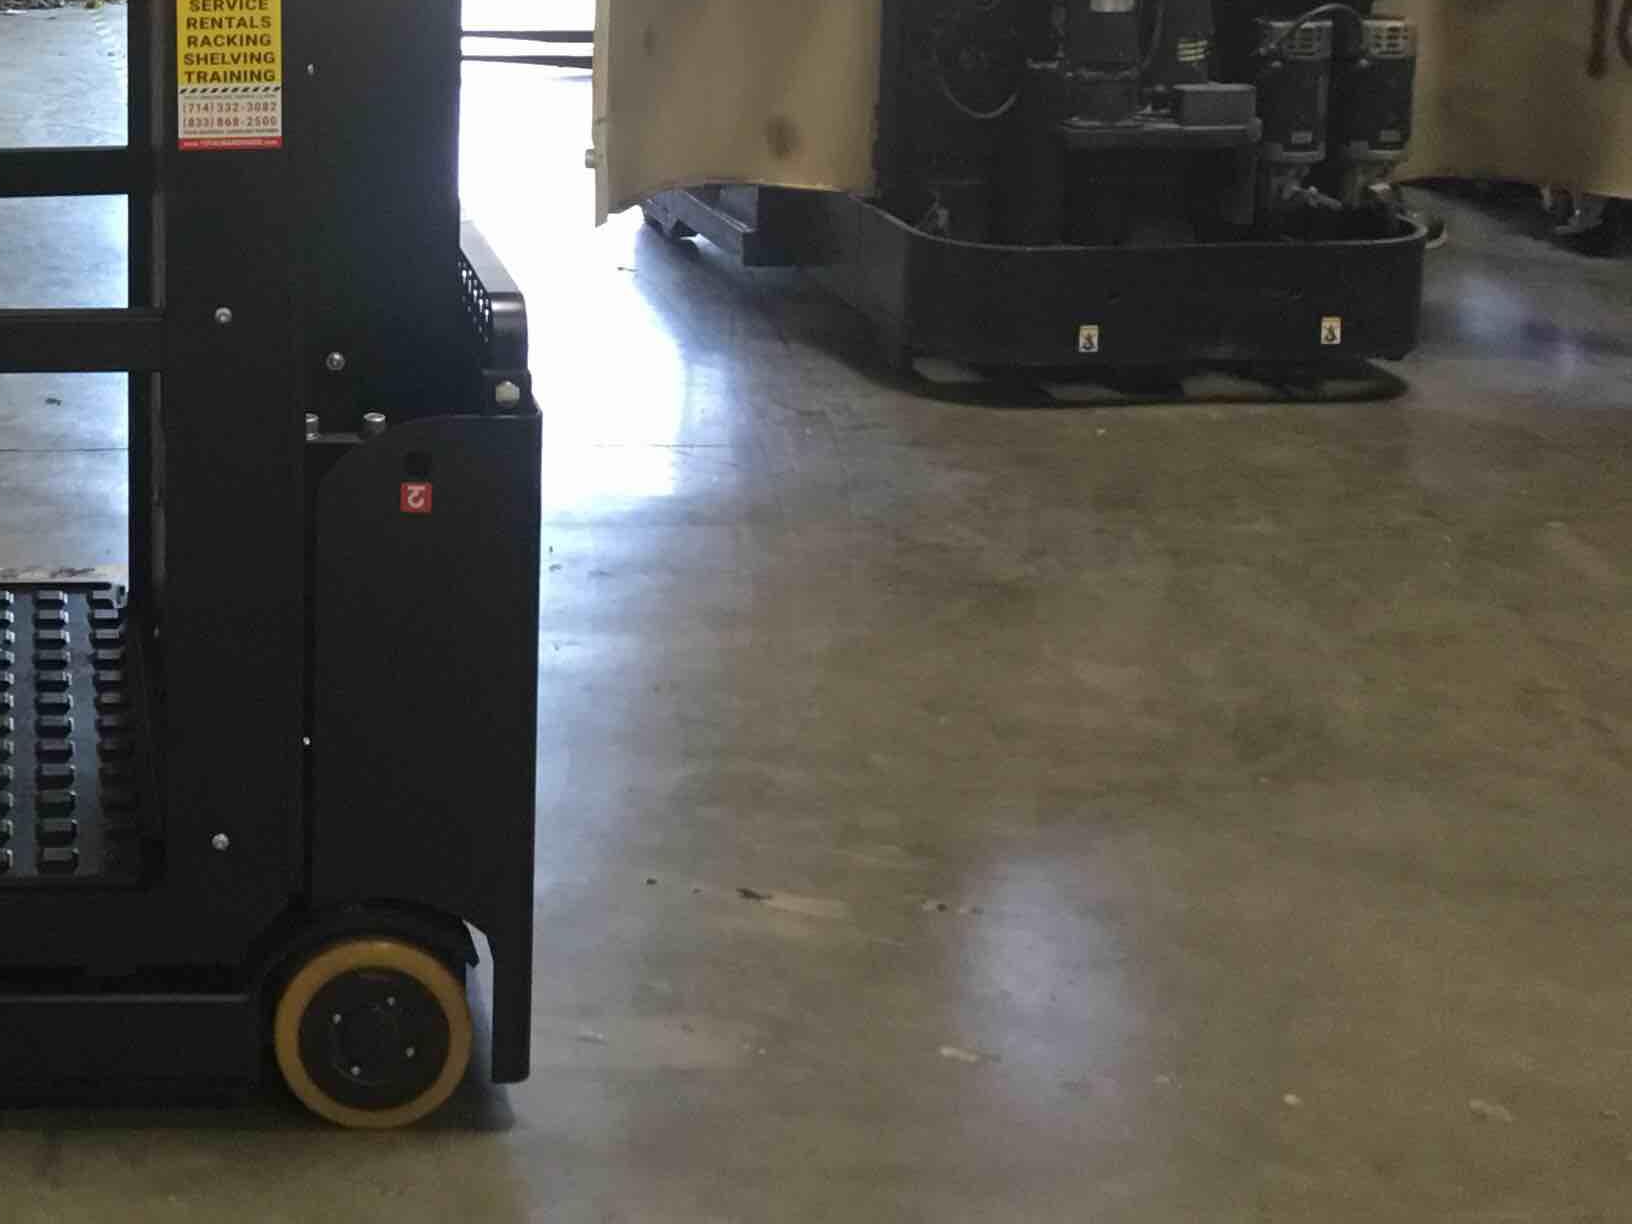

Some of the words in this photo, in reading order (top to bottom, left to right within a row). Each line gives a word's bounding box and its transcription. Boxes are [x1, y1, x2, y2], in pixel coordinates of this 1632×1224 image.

[186, 16, 272, 31] RENTALS
[186, 33, 272, 49] RACKING
[183, 51, 275, 67] SHELVING
[183, 69, 276, 85] TRAINING
